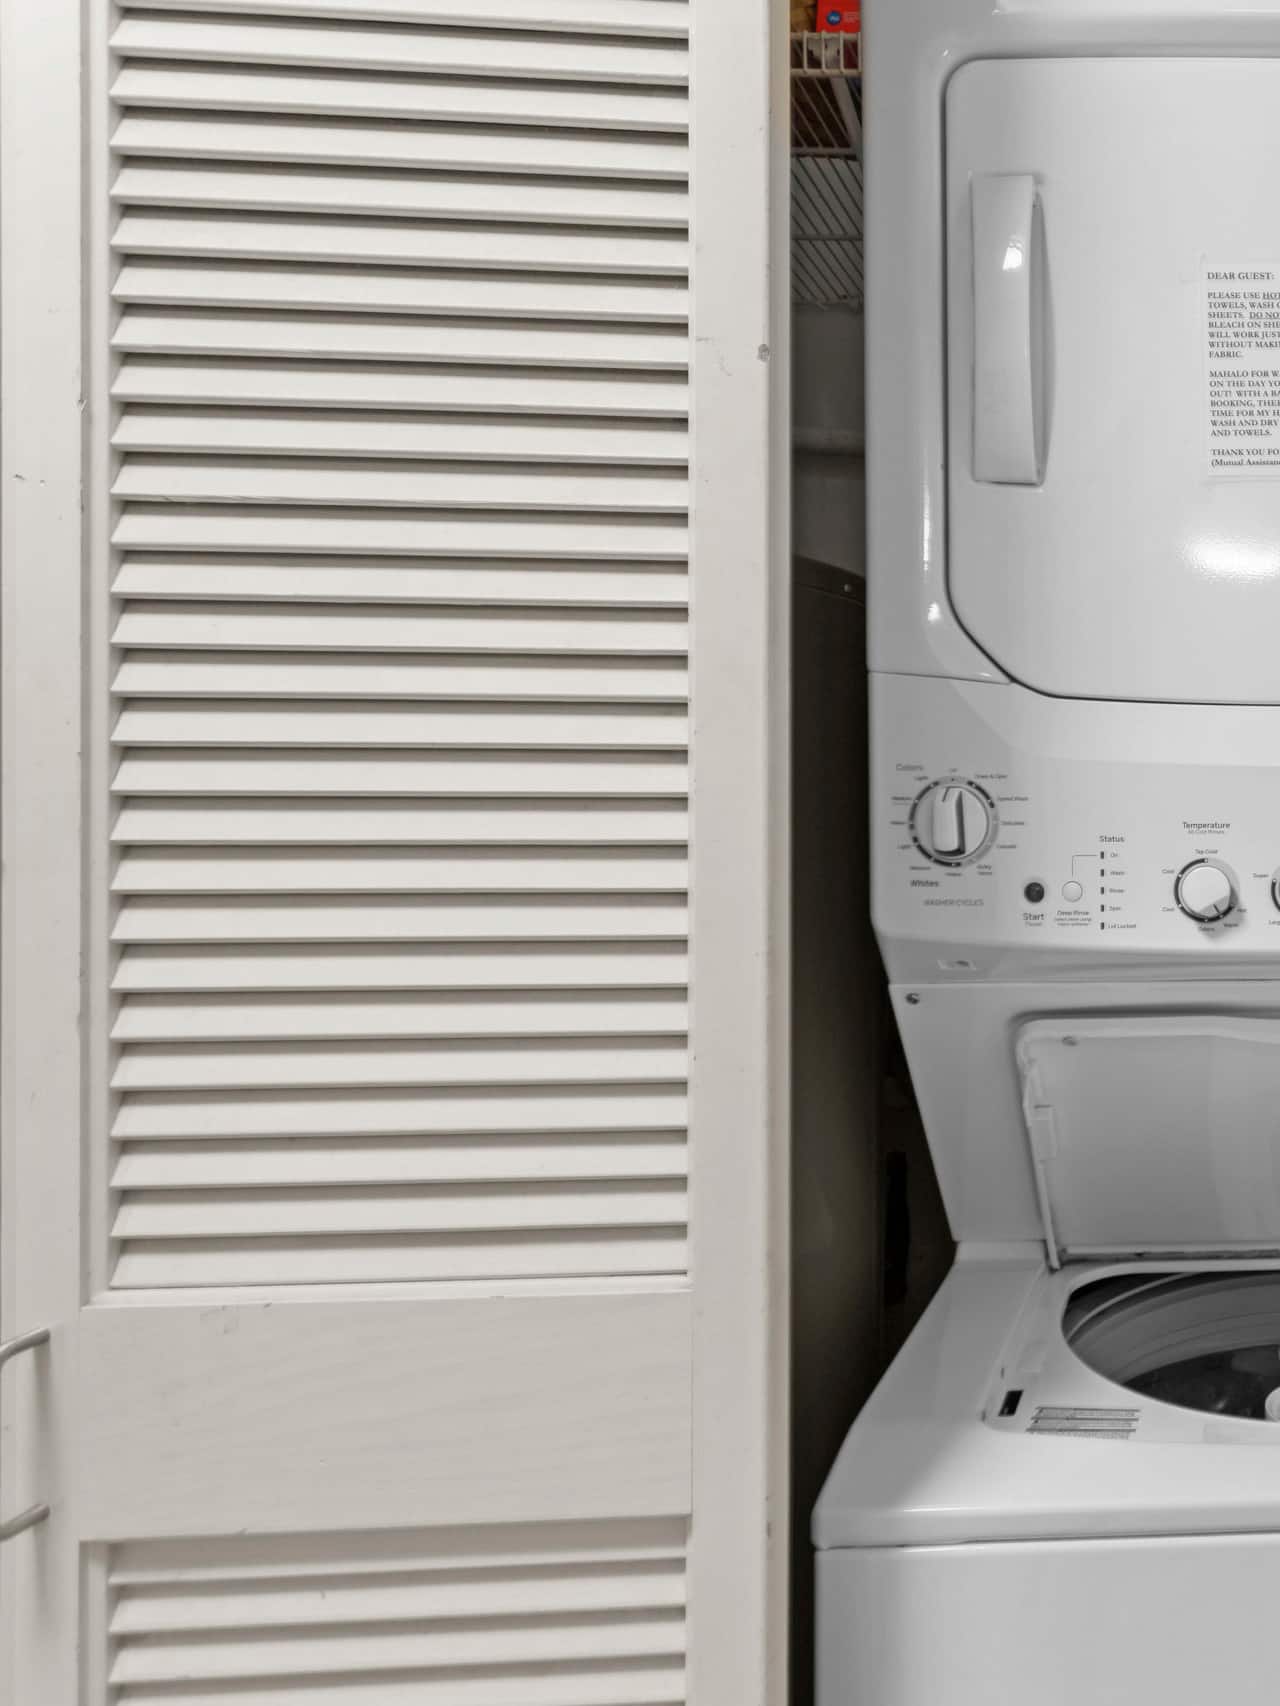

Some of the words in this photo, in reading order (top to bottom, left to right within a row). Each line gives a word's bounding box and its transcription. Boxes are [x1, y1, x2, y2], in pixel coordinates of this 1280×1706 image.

[1207, 272, 1236, 280] DEAR
[1238, 272, 1275, 280] GUEST:
[1249, 312, 1263, 320] DO
[1210, 409, 1234, 417] TIME
[1236, 409, 1254, 417] FOR
[1256, 409, 1270, 417] MY
[1183, 822, 1230, 830] Temperature
[1023, 912, 1045, 920] Start
